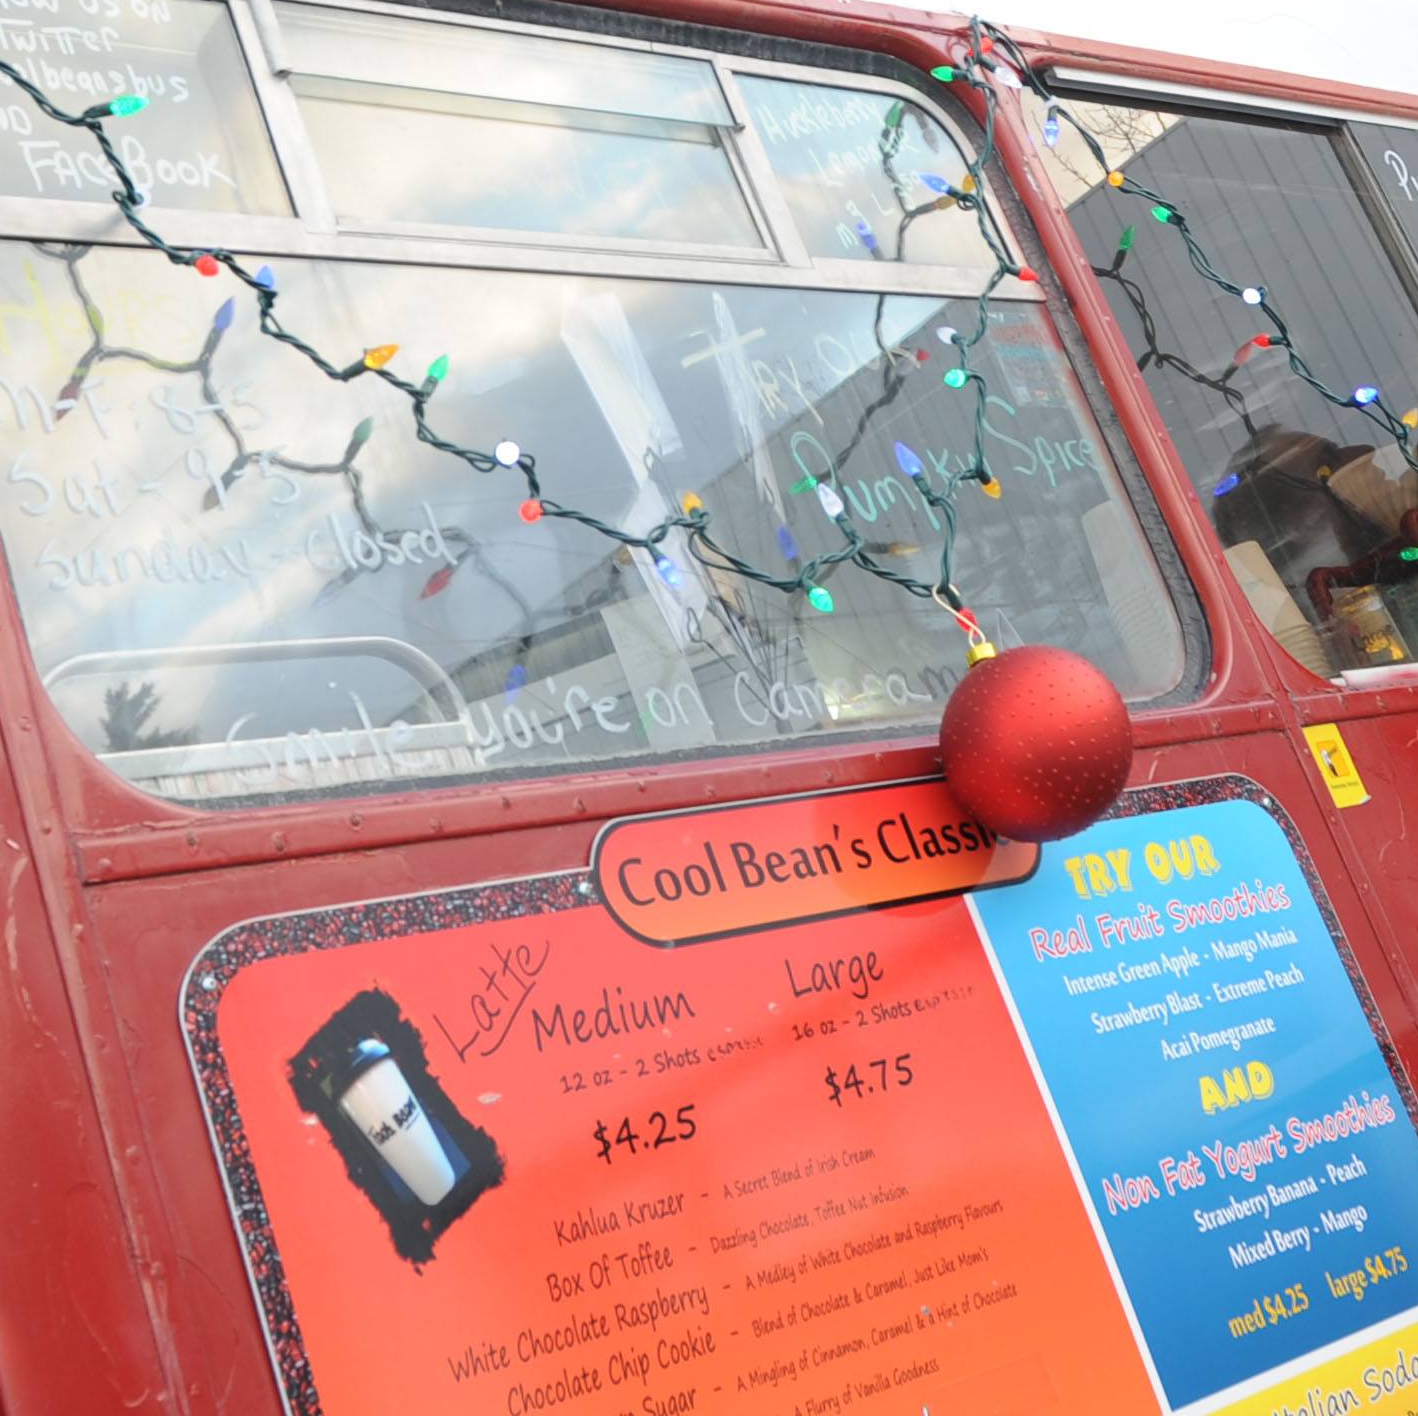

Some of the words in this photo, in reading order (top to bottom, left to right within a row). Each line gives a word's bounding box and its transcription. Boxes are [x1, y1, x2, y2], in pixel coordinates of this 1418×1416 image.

[982, 395, 1103, 488] Spice
[7, 448, 124, 517] Sat
[645, 682, 715, 728] on
[617, 841, 728, 907] Cool
[730, 822, 874, 890] Bean's
[1064, 848, 1134, 900] TRY
[1144, 834, 1222, 884] OUR
[1028, 914, 1093, 962] Real
[1095, 902, 1165, 949] Fruit
[1166, 879, 1292, 933] Smoothies
[783, 948, 885, 1000] Large
[1062, 971, 1119, 997] Intense
[1117, 960, 1161, 983] Green
[1160, 945, 1201, 978] Apple
[1210, 940, 1258, 963] Mango
[1255, 925, 1299, 951] Mania
[531, 986, 696, 1053] Medium
[791, 1021, 815, 1042] 16
[819, 1019, 838, 1036] oz
[855, 1010, 869, 1027] 2
[870, 1000, 913, 1025] Shots
[1090, 1001, 1169, 1035] Strawberry
[1165, 991, 1203, 1016] Blast
[1212, 977, 1268, 1004] Extreme
[1264, 962, 1305, 987] Peach
[560, 1072, 588, 1095] 12
[592, 1069, 614, 1088] oz
[634, 1058, 651, 1078] 2
[653, 1045, 701, 1074] Shots
[1160, 1034, 1194, 1061] Acai
[1190, 1014, 1277, 1052] Pomegranate
[823, 1052, 914, 1108] $4.75
[1198, 1059, 1275, 1116] AND
[592, 1103, 698, 1165] $4.25
[1101, 1171, 1160, 1218] Non
[1158, 1149, 1206, 1198] Fat
[1201, 1124, 1288, 1183] Yogurt
[1285, 1089, 1397, 1155] Smoothies
[553, 1207, 622, 1247] Kahlua
[623, 1191, 686, 1227] Kruzer
[734, 1176, 770, 1198] Secret
[771, 1167, 802, 1189] Blend
[818, 1155, 840, 1175] Irish
[841, 1147, 876, 1168] Cream
[1193, 1194, 1271, 1233] Strawberry
[1268, 1175, 1319, 1208] Banana
[1326, 1153, 1368, 1186] Peach
[545, 1272, 585, 1303] Box
[588, 1252, 613, 1290] Of
[614, 1240, 674, 1281] Toffee
[709, 1228, 759, 1255] Dazzling
[759, 1211, 814, 1240] Chocolate,
[814, 1200, 846, 1223] Toffee
[848, 1195, 869, 1215] Nut
[1228, 1234, 1274, 1270] Mixed
[1271, 1224, 1312, 1251] Berry
[1320, 1204, 1369, 1235] Mango
[447, 1340, 511, 1385] White
[516, 1313, 611, 1364] Chocolate
[614, 1286, 710, 1333] Raspberry
[756, 1264, 797, 1287] Medley
[809, 1248, 842, 1273] White
[843, 1232, 893, 1264] Chocolate
[893, 1227, 913, 1244] and
[914, 1210, 965, 1240] Raspberry
[963, 1198, 1005, 1224] Flavours
[1228, 1299, 1266, 1338] med
[1263, 1282, 1311, 1326] $4.25
[1325, 1270, 1369, 1301] large
[1365, 1245, 1409, 1286] $4.75
[506, 1366, 603, 1416] Chocolate
[607, 1346, 651, 1387] Chip
[656, 1324, 718, 1369] Cookie
[750, 1314, 785, 1339] Blend
[799, 1291, 851, 1323] Chocolate
[865, 1272, 913, 1300] Caramel,
[913, 1265, 936, 1292] Just
[936, 1257, 958, 1279] Like
[957, 1245, 991, 1271] Mom's
[640, 1387, 698, 1416] Sugar
[748, 1359, 798, 1388] Mingling
[812, 1337, 870, 1368] Cinnamon,
[870, 1318, 915, 1347] Caramel
[937, 1302, 960, 1323] Hint
[972, 1282, 1018, 1311] Chocolate
[853, 1374, 892, 1400] Vanilla
[892, 1357, 941, 1387] Goodness
